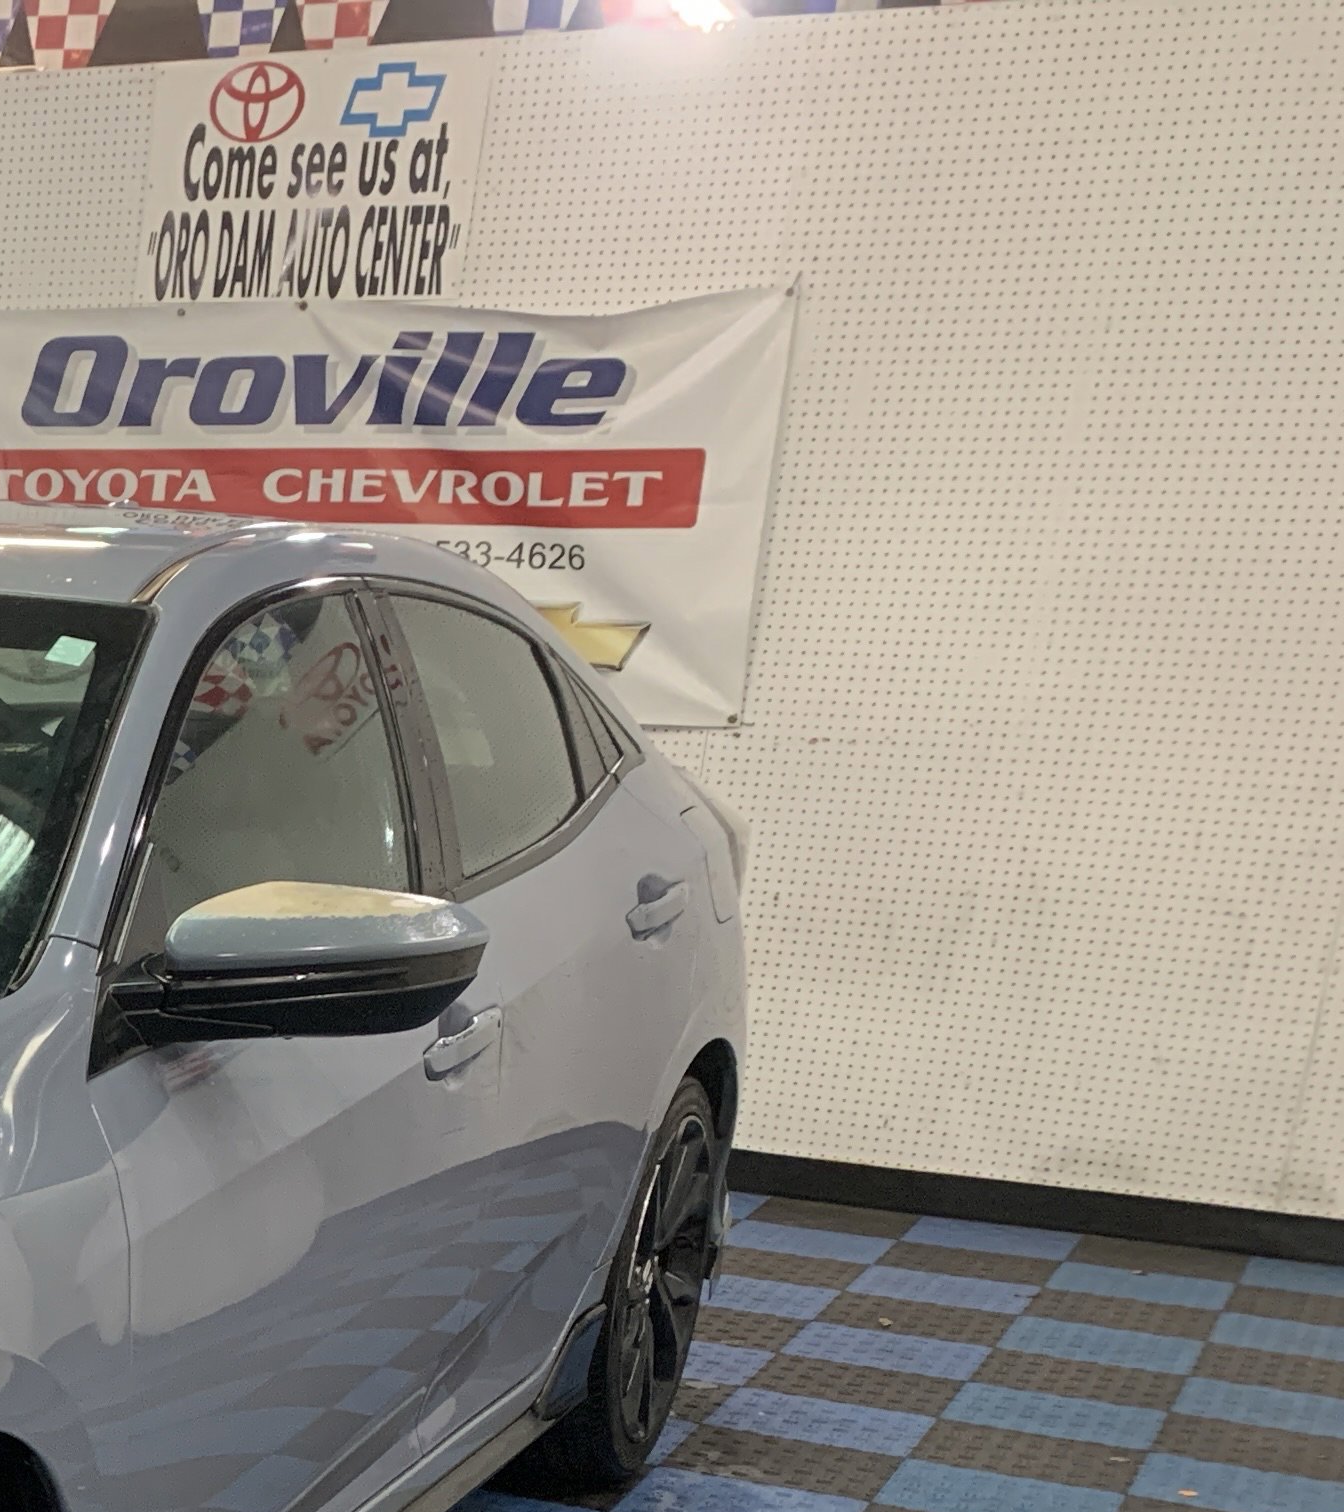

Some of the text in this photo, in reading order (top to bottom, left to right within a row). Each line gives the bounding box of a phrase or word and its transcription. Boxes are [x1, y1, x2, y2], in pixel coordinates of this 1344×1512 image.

[183, 122, 451, 202] Come see us at,
[212, 210, 276, 298] DAM
[276, 204, 351, 299] AUTO
[20, 331, 628, 428] Oroville
[263, 467, 663, 508] CHEVROLET
